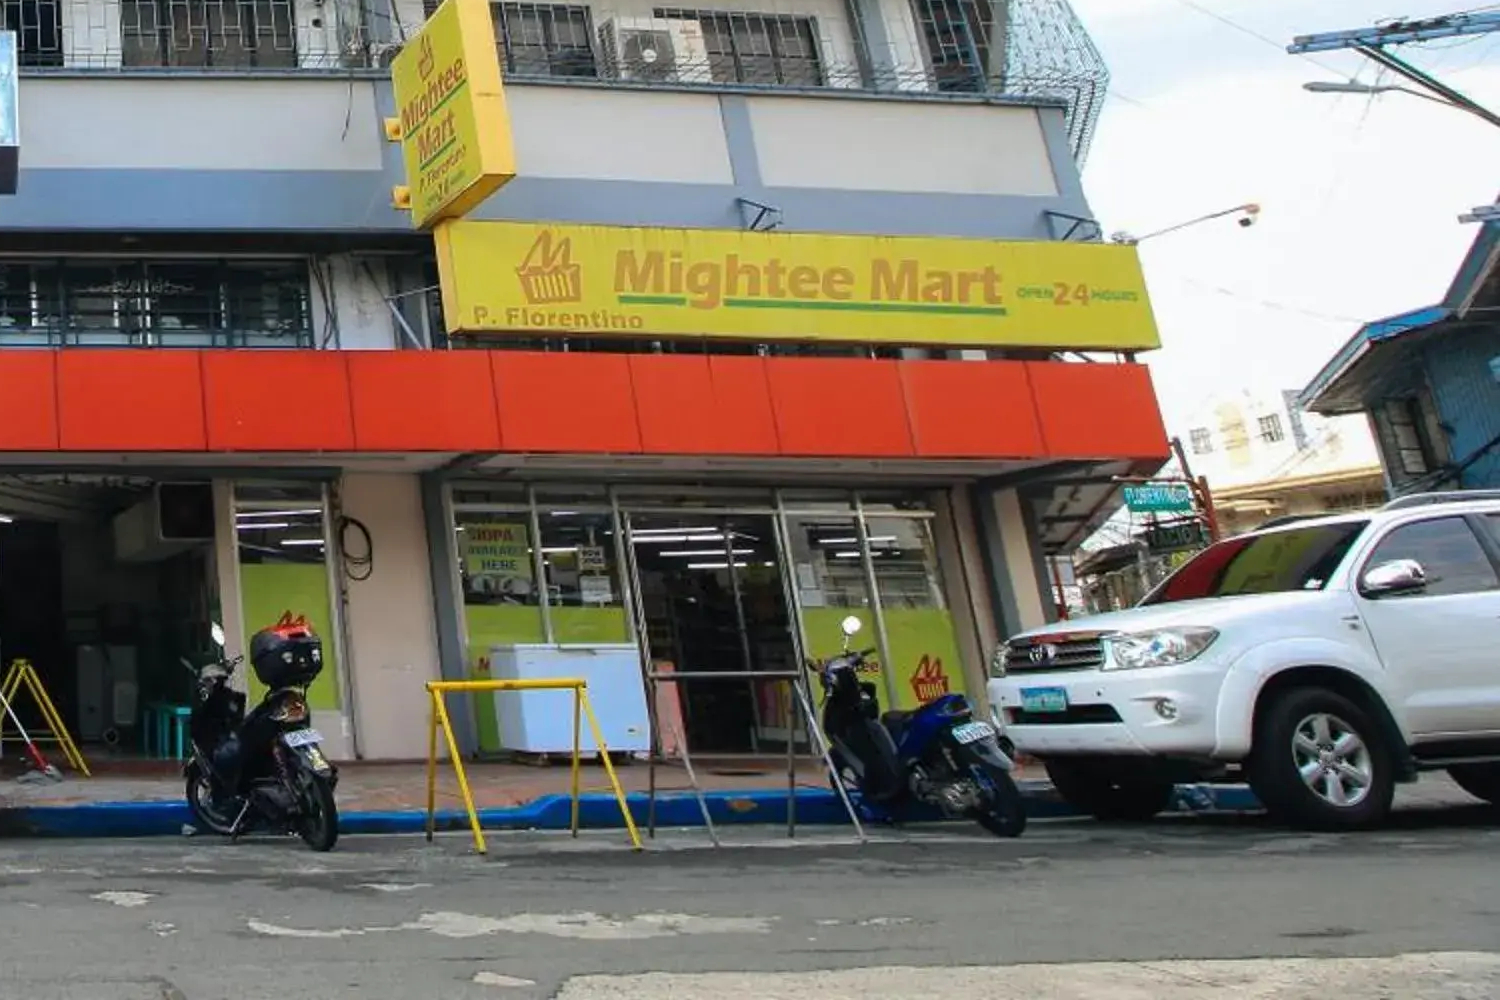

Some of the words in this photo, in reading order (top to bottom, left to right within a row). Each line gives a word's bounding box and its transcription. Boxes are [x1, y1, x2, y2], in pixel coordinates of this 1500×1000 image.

[401, 57, 466, 134] Mightee
[416, 108, 457, 164] Mart
[613, 249, 855, 311] Mightee
[870, 258, 1003, 306] Mart
[1016, 286, 1054, 300] OPEN
[1053, 281, 1091, 307] 24
[473, 305, 498, 326] P.
[506, 306, 644, 330] Florentino
